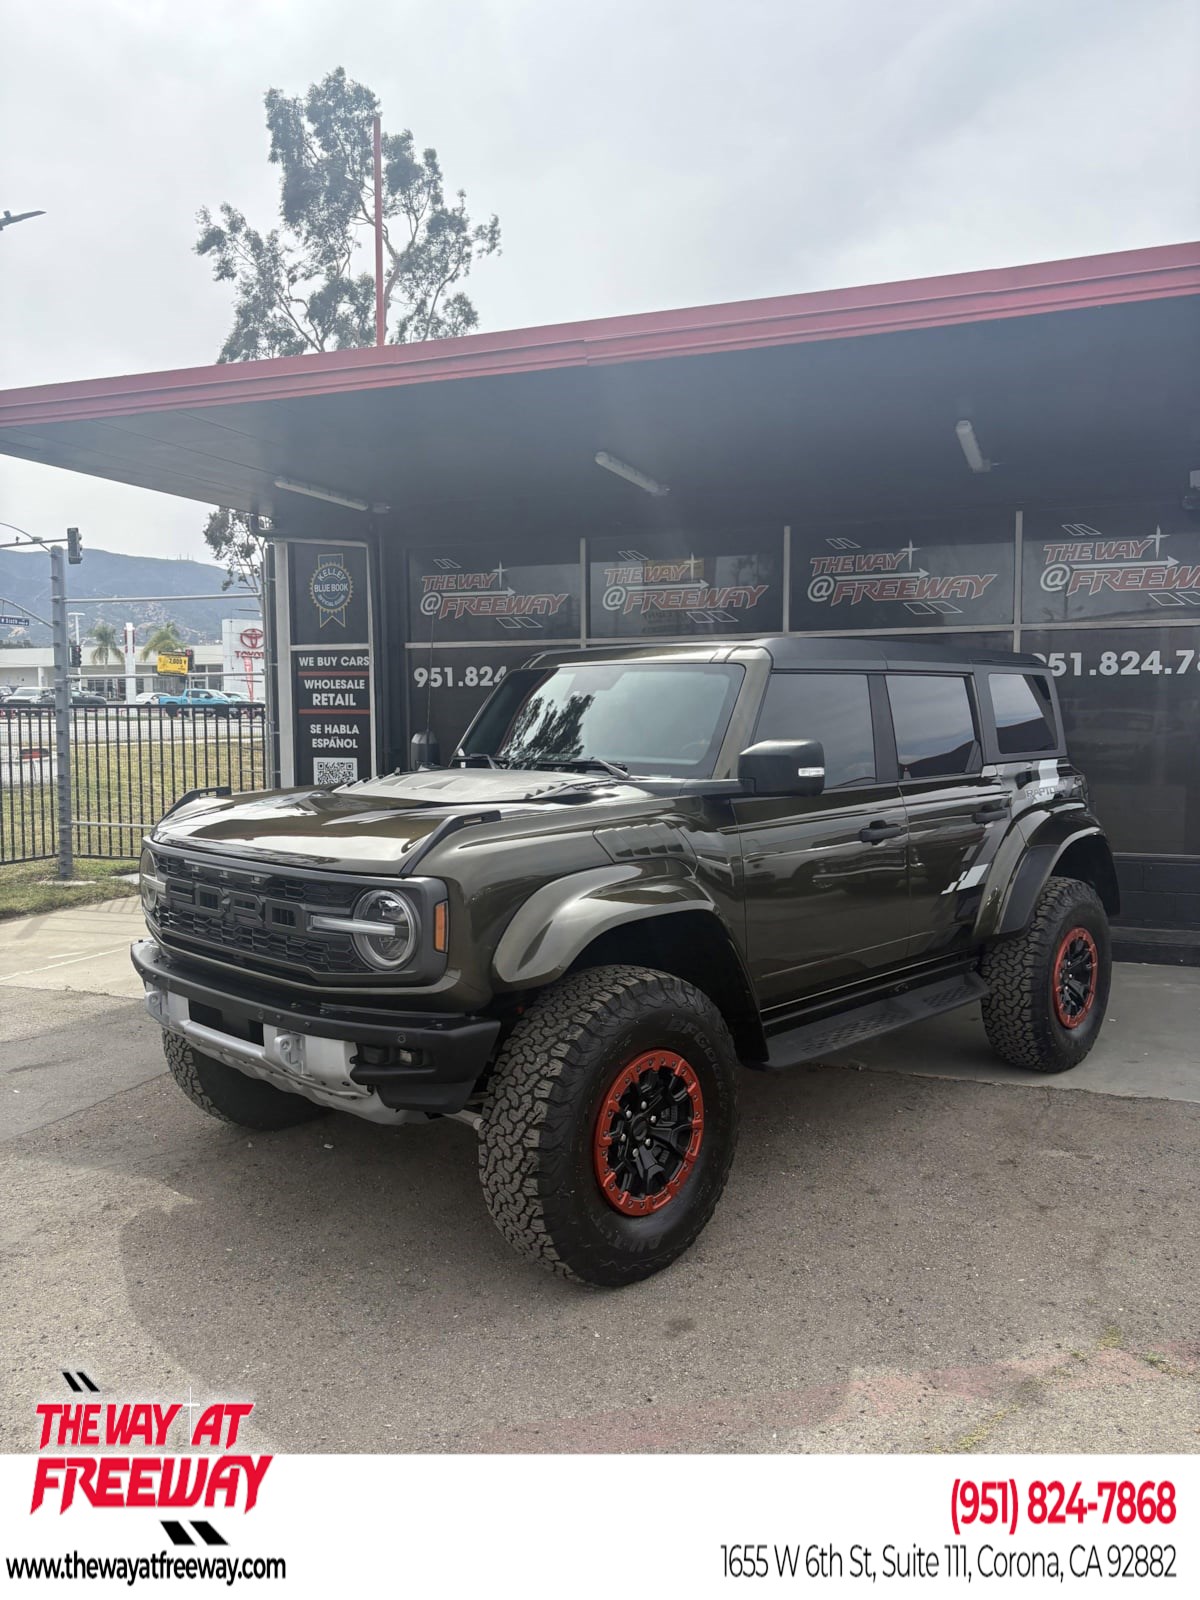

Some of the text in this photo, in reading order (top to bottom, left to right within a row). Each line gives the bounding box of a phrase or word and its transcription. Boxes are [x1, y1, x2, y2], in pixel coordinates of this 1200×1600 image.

[1043, 539, 1155, 565] THE WAY
[809, 552, 906, 576] THE WAY
[317, 568, 346, 581] KELLEY
[604, 564, 690, 587] THE WAY
[314, 583, 348, 592] BLUE BOOK
[421, 573, 497, 592] THE WAY
[235, 651, 264, 659] TOYOT
[299, 656, 370, 666] WE BUY CARS
[304, 679, 365, 689] WHOLESALE
[312, 693, 356, 706] RETAIL
[310, 724, 360, 734] SE HABLA
[1026, 786, 1057, 801] RAPTO
[166, 876, 304, 930] FORD
